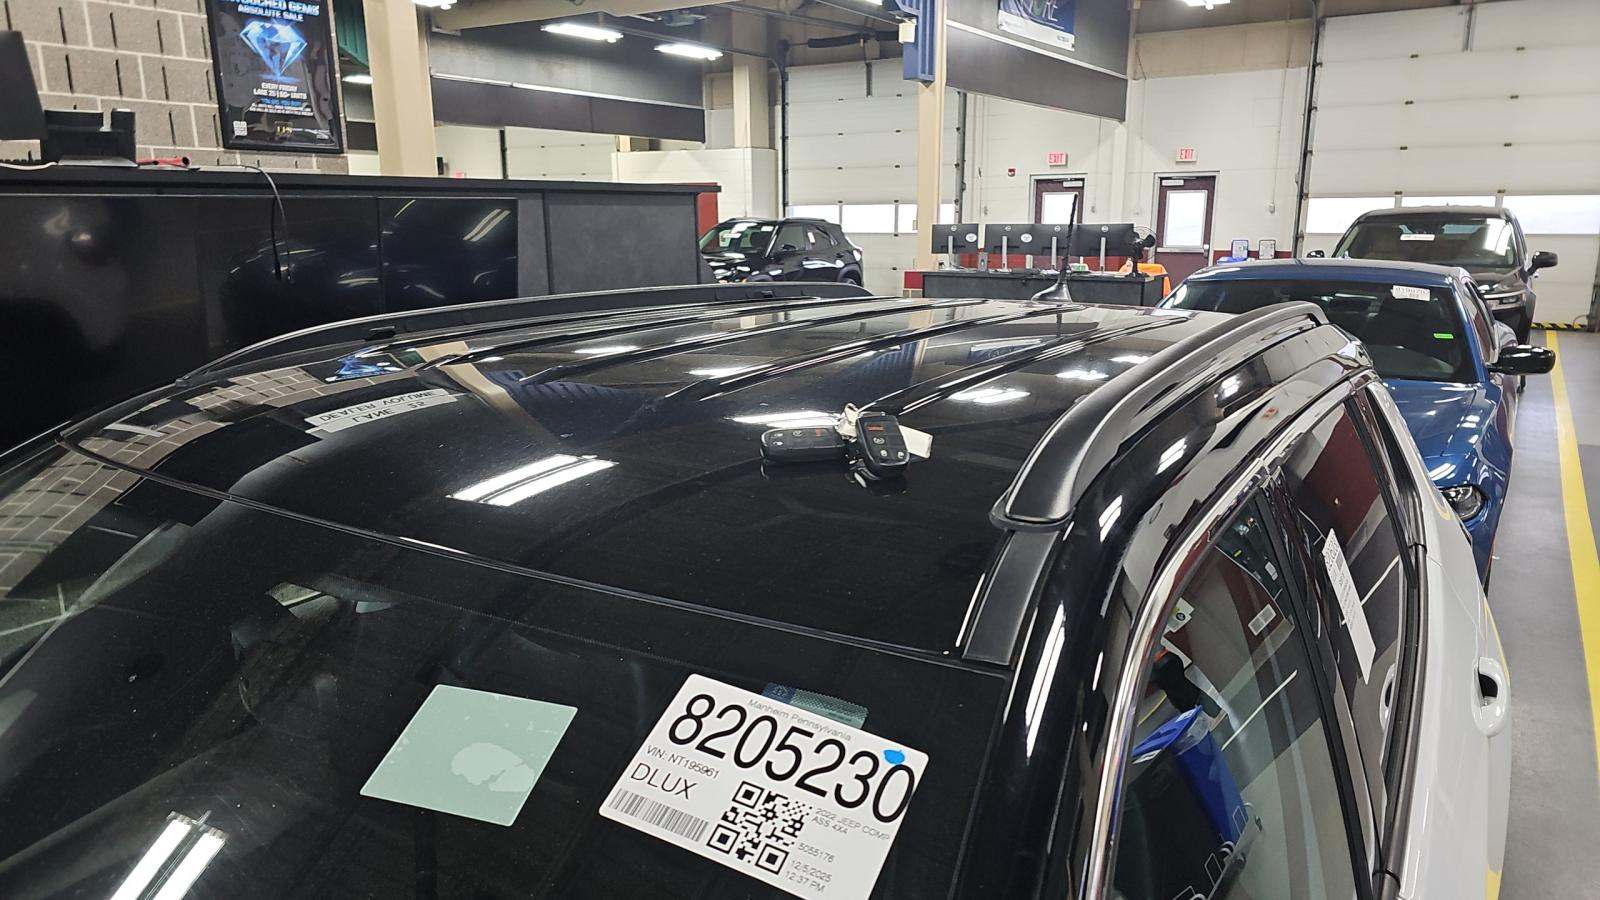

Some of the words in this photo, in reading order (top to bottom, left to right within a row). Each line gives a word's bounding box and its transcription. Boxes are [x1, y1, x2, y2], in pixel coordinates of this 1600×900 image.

[238, 4, 282, 18] ABSOLUTE
[282, 11, 304, 21] SALE
[288, 1, 320, 16] GEMS
[748, 698, 790, 719] Manheim
[791, 713, 852, 741] Pennsylvania
[646, 744, 667, 760] VIN:
[667, 753, 720, 780] NT195961
[668, 693, 916, 823] 8205230
[631, 762, 699, 800] DLUX
[815, 807, 837, 821] 2022
[836, 817, 862, 829] JEEP
[809, 880, 826, 893] PM
